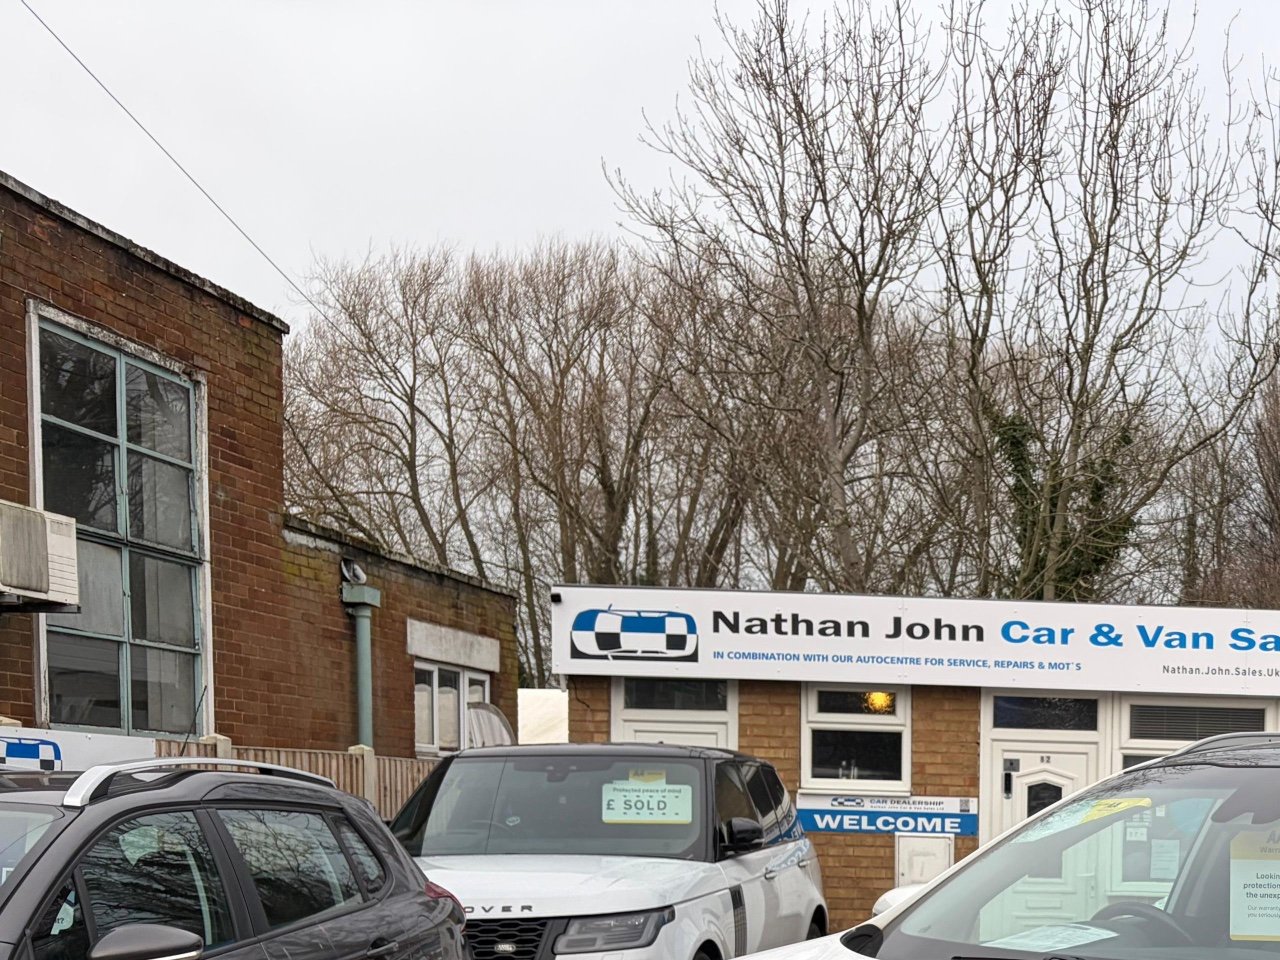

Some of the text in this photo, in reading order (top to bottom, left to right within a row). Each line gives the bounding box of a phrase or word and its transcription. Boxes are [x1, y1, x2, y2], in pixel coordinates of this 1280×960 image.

[713, 610, 870, 638] Nathan
[885, 616, 984, 642] John
[1001, 620, 1075, 645] Car
[1089, 623, 1123, 647] &
[1136, 624, 1214, 650] Van
[713, 651, 724, 660] IN
[727, 651, 800, 662] COMBINATION
[802, 653, 829, 663] WITH
[831, 654, 853, 663] OUR
[855, 655, 922, 665] AUTOCENTRE
[924, 657, 944, 666] FOR
[947, 658, 991, 669] SERVICE,
[993, 660, 1035, 670] REPAIRS
[1037, 661, 1045, 670] &
[606, 799, 667, 811] £ SOLD
[813, 813, 961, 833] WELCOME
[1243, 882, 1280, 890] protection
[463, 905, 533, 914] OVER
